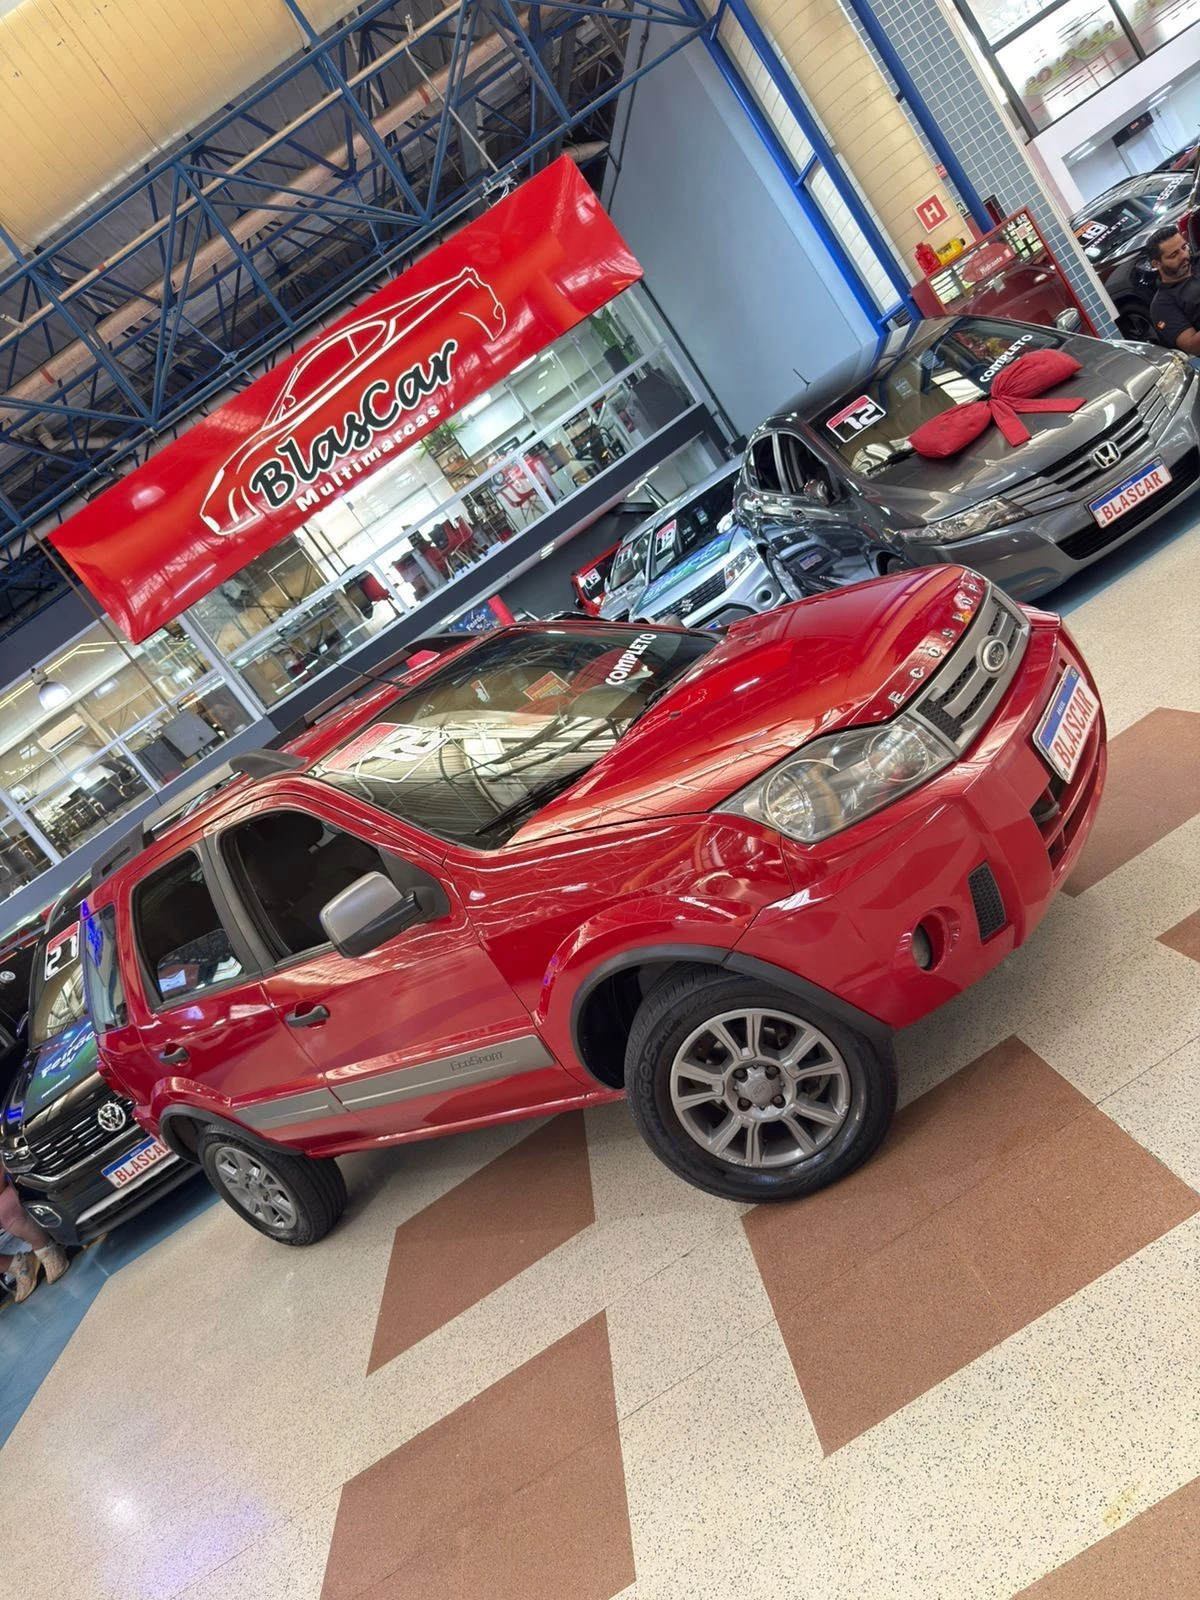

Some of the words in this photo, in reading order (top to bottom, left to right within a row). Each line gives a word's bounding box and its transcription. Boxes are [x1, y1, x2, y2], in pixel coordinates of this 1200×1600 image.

[1087, 216, 1129, 252] OMPLETO
[979, 334, 1033, 383] COMPLETO
[250, 339, 458, 509] BlasCar
[843, 402, 882, 431] 12
[293, 404, 441, 512] Multimarcas
[1101, 470, 1164, 521] BLASCAR
[604, 633, 657, 686] COMPLETO
[1053, 686, 1095, 769] BLASCAR
[47, 934, 78, 977] 21
